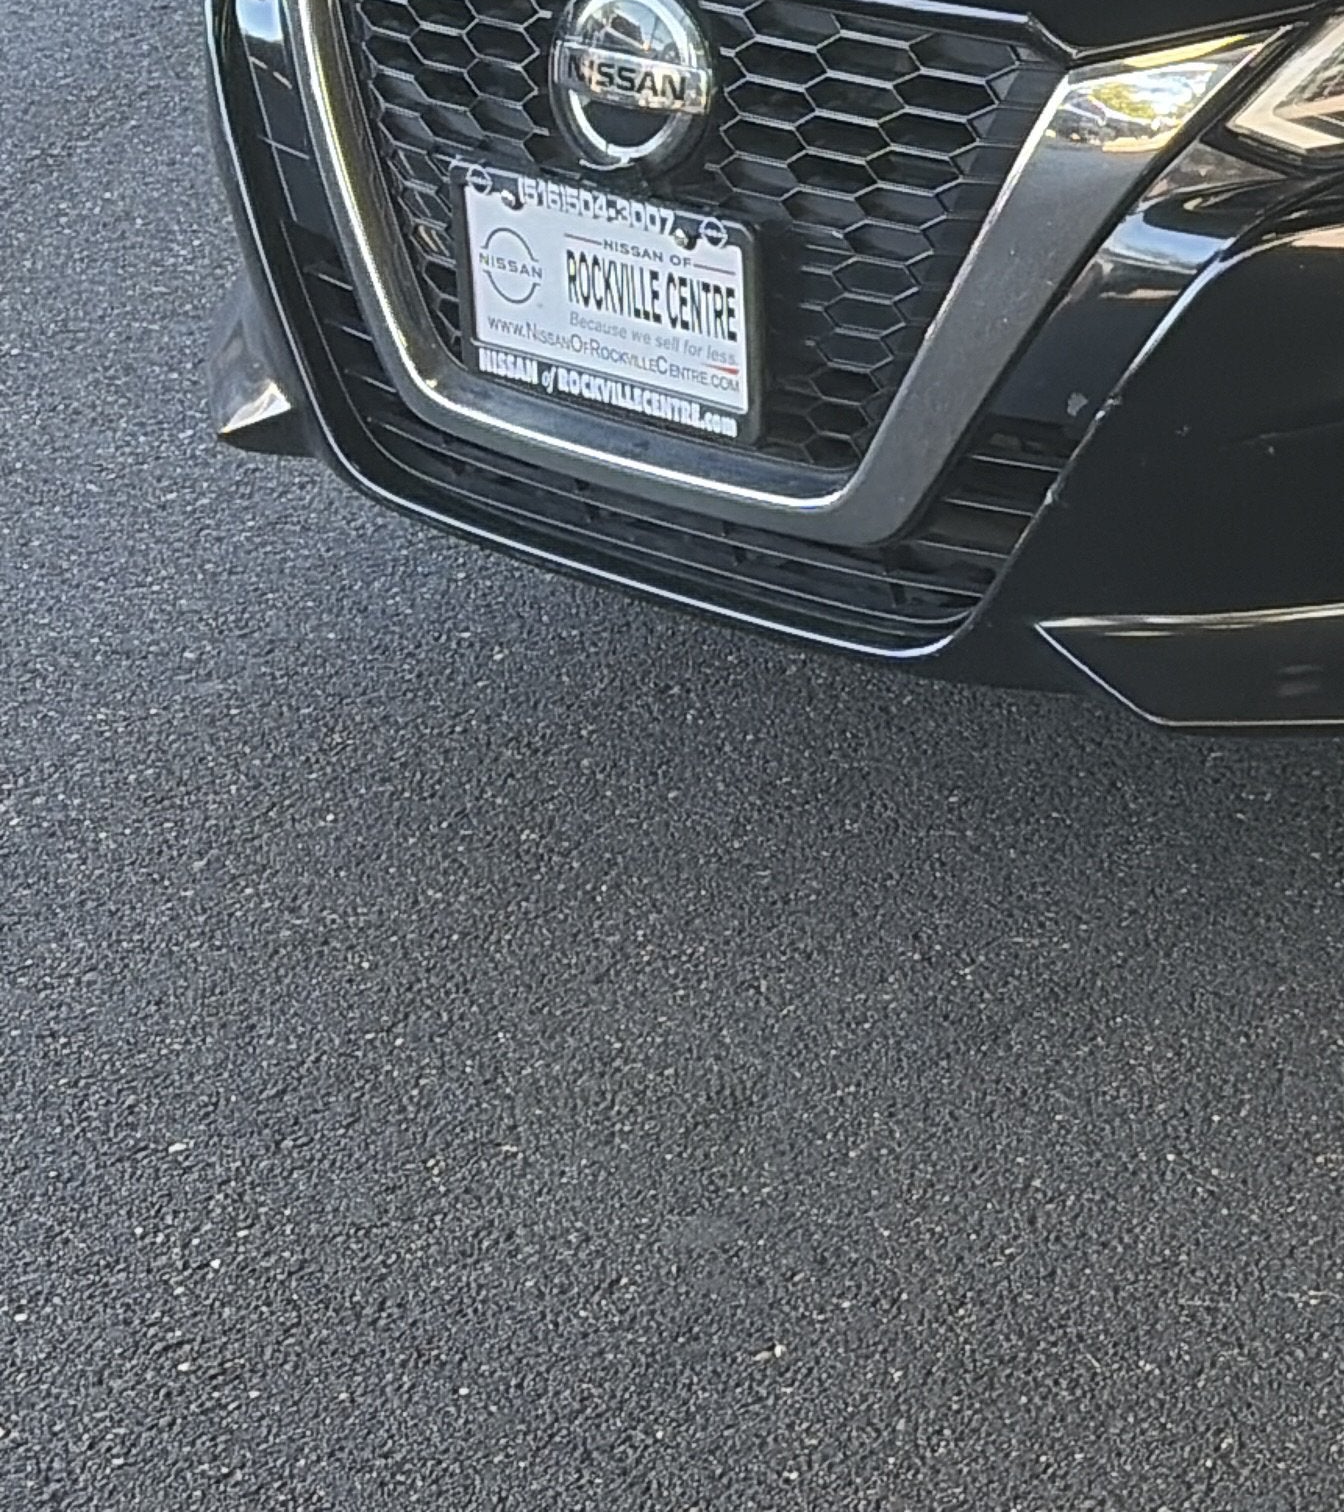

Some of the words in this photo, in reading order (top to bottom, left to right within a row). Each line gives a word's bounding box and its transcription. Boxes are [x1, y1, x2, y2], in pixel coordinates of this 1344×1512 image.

[568, 54, 687, 100] NISSAN
[479, 253, 543, 279] NISSAN
[603, 240, 664, 263] NISSAN
[669, 254, 692, 268] OF
[566, 249, 662, 325] ROCKVILLE
[667, 272, 738, 343] CENTRE
[569, 311, 628, 340] Because
[632, 328, 652, 345] we
[655, 335, 680, 354] sell
[683, 340, 703, 357] for
[478, 347, 538, 385] NISSAN
[541, 365, 556, 394] of
